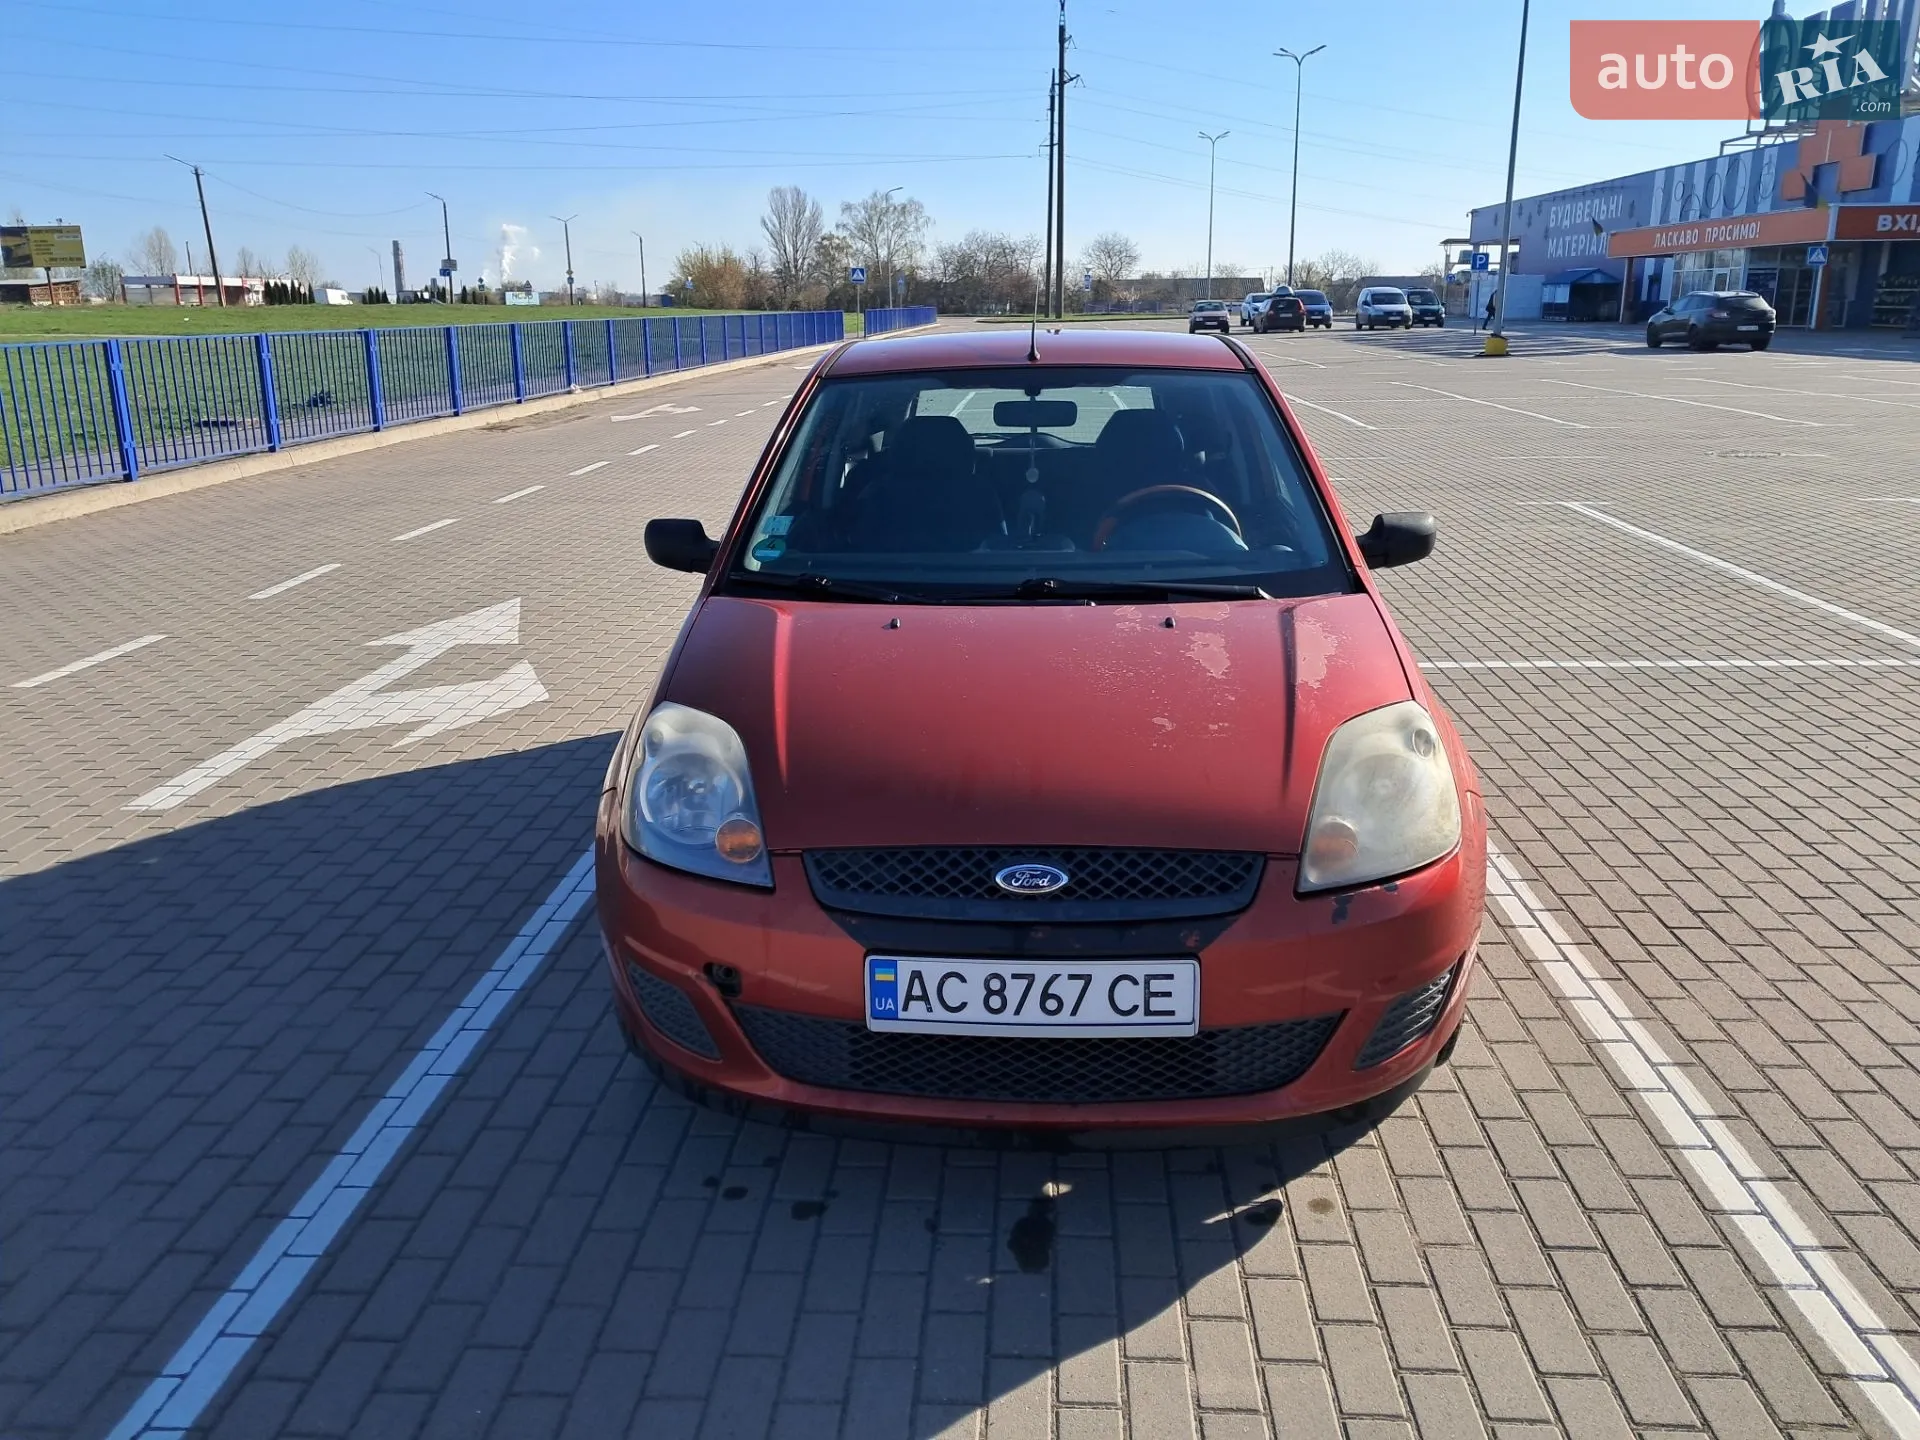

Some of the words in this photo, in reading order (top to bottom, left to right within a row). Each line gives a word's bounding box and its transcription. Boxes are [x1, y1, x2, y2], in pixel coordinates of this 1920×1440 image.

[1549, 194, 1623, 229] БУДІВЕЛЬНІ
[1876, 213, 1920, 233] ВХІ
[1654, 228, 1699, 248] ЛАСКАВО
[1704, 221, 1761, 244] ПРОСИМО!
[1011, 870, 1051, 887] Ford
[875, 997, 895, 1011] UA
[901, 970, 968, 1014] AC
[982, 972, 1093, 1017] 8767
[1107, 973, 1176, 1017] CE
